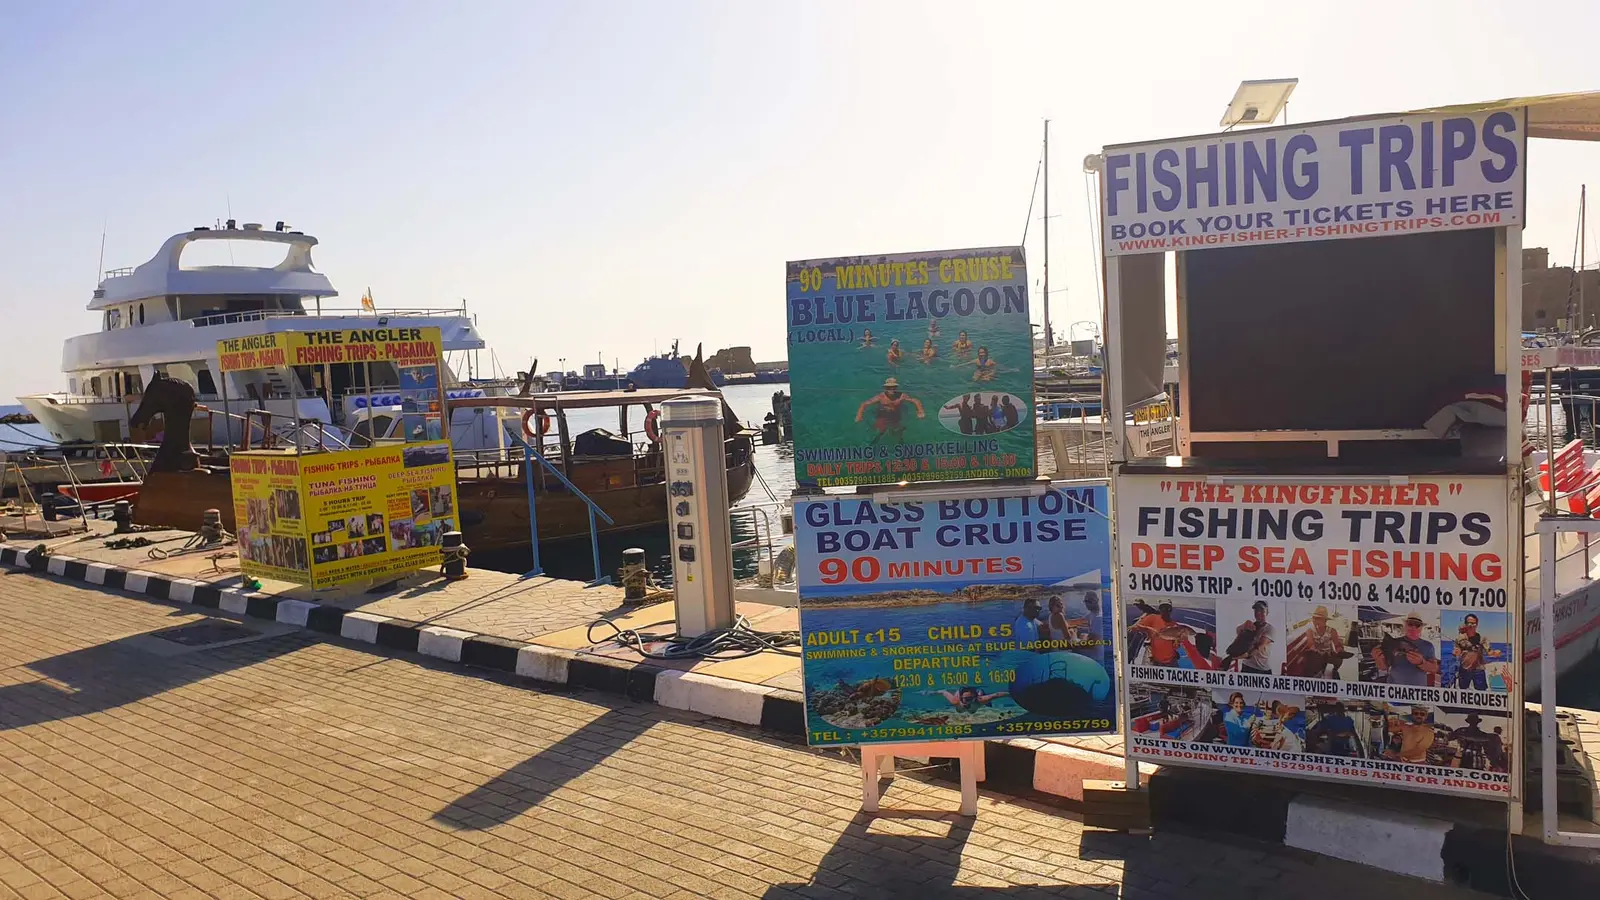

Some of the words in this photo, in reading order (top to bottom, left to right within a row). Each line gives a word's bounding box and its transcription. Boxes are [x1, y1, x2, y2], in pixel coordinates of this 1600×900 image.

[1106, 134, 1319, 216] FISHING
[1339, 111, 1518, 195] TRIPS
[1111, 219, 1187, 240] BOOK
[1196, 212, 1274, 233] YOUR
[1283, 200, 1414, 226] TICKETS
[1426, 191, 1513, 215] HERE
[1118, 212, 1500, 251] WWW.KINGFISHER-FISHINGTRIPS.COM
[800, 267, 823, 293] 90
[835, 260, 929, 290] MINUTES
[938, 256, 1014, 283] CRUISE
[791, 293, 876, 326] BLUE
[885, 285, 1025, 321] LAGOON
[223, 338, 241, 353] THE
[241, 335, 277, 351] ANGLER
[305, 331, 343, 345] THE
[349, 328, 422, 343] ANGLER
[297, 345, 343, 364] FISHING
[345, 343, 377, 362] TRIPS
[1151, 424, 1171, 437] ANGLER
[796, 446, 876, 462] SWIMMING
[880, 445, 889, 458] &
[894, 439, 999, 458] SNORKELLING
[304, 462, 336, 475] FISHING
[337, 458, 359, 470] TRIPS
[807, 462, 841, 477] DAILY
[846, 460, 882, 475] TRIPS
[920, 459, 930, 471] &
[970, 455, 980, 467] &
[965, 468, 999, 480] ANDROS
[1005, 467, 1032, 478] DINOS
[309, 481, 336, 490] TUNA
[338, 475, 377, 486] FISHING
[329, 498, 351, 506] HOURS
[805, 500, 925, 527] GLASS
[938, 488, 1095, 521] BOTTOM
[816, 526, 921, 554] BOAT
[935, 518, 1088, 548] CRUISE
[1137, 506, 1324, 542] FISHING
[1341, 510, 1492, 546] TRIPS
[818, 556, 881, 585] 90
[888, 556, 1023, 579] MINUTES
[1131, 542, 1225, 571] DEEP
[1237, 545, 1315, 575] SEA
[1327, 549, 1502, 583] FISHING
[1128, 572, 1137, 591] 3
[1141, 573, 1194, 593] HOURS
[1198, 576, 1233, 595] TRIP
[1251, 578, 1293, 598] 10:00
[1297, 581, 1314, 599] to
[1318, 581, 1362, 601] 13:00
[1367, 583, 1380, 602] &
[1385, 584, 1430, 606] 14:00
[1436, 587, 1453, 606] to
[1459, 587, 1506, 608] 17:00
[807, 630, 860, 646] ADULT
[864, 628, 901, 644] €15
[927, 624, 982, 641] CHILD
[988, 624, 1012, 638] €5
[806, 648, 866, 660] SWIMMING
[870, 647, 878, 656] &
[882, 643, 964, 656] SNORKELLING
[967, 642, 982, 652] AT
[985, 641, 1016, 652] BLUE
[1019, 639, 1068, 650] LAGOON
[893, 656, 981, 671] DEPARTURE
[894, 674, 921, 688] 12:30
[927, 673, 935, 685] &
[941, 671, 968, 685] 15:00
[974, 671, 982, 683] &
[988, 669, 1016, 683] 16:30
[1131, 666, 1165, 681] FISHING
[1166, 669, 1199, 684] TACKLE
[1206, 672, 1226, 686] BAIT
[1229, 674, 1235, 687] &
[1237, 676, 1271, 689] DRINKS
[1272, 678, 1290, 691] ARE
[1293, 679, 1338, 695] PROVIDED
[1346, 683, 1386, 699] PRIVATE
[1388, 686, 1440, 703] CHARTERS
[1442, 690, 1458, 704] ON
[1460, 692, 1509, 708] REQUEST
[813, 730, 842, 742] TEL
[861, 724, 973, 738] +35799411885
[996, 718, 1110, 733] +35799655759
[1132, 746, 1161, 756] FOR
[1163, 749, 1229, 763] BOOKING
[1231, 756, 1261, 767] TEL.
[1264, 760, 1368, 778] +35799411885
[1371, 770, 1402, 781] ASK
[1405, 774, 1439, 786] FOR
[1442, 778, 1512, 793] ANDROS
[1134, 737, 1169, 748] VISIT
[1171, 741, 1187, 750] US
[1192, 743, 1210, 753] ON
[1211, 745, 1508, 783] WWW.KINGFISHER-FISHINGTRIPS.COM
